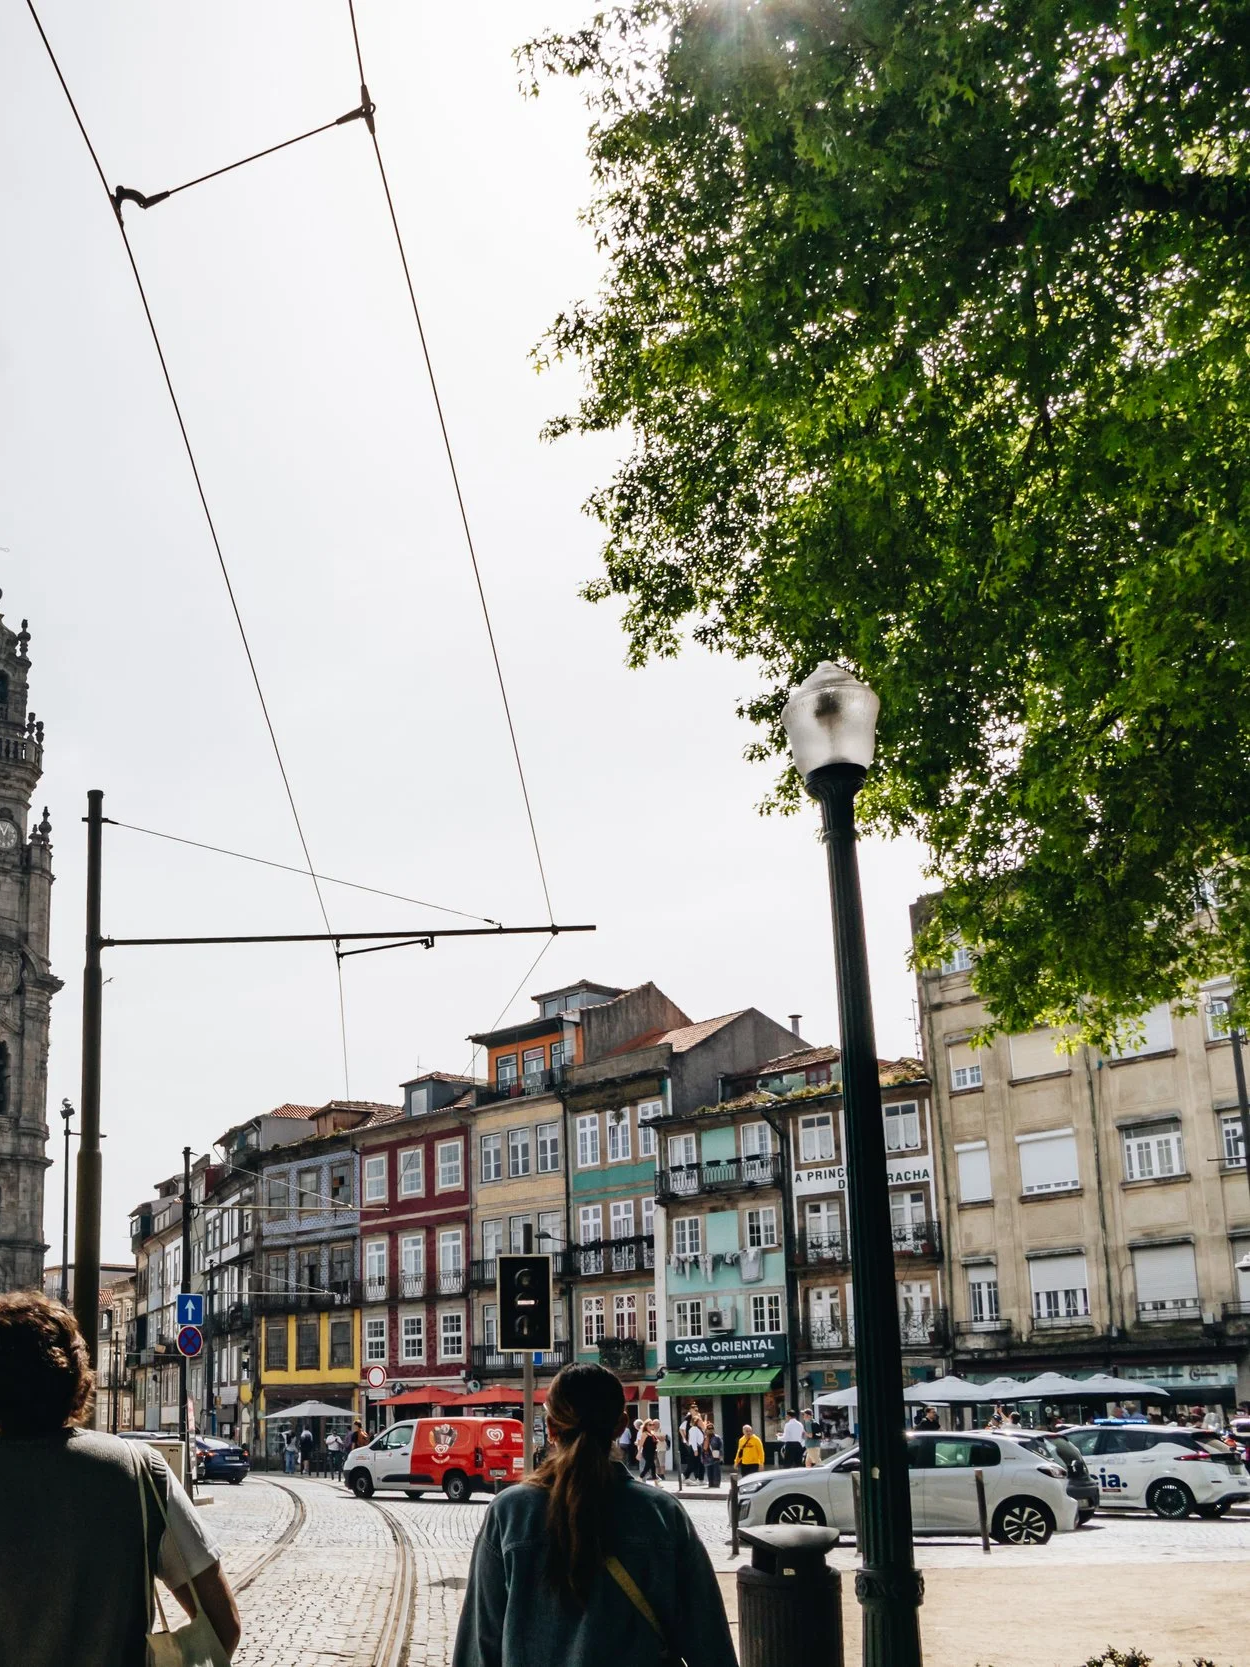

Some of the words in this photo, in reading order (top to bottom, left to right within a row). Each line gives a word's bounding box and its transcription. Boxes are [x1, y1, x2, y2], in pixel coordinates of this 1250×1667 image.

[795, 1173, 802, 1183] A
[807, 1168, 846, 1181] PRINC
[675, 1343, 708, 1354] CASA
[711, 1339, 775, 1352] ORIENTAL
